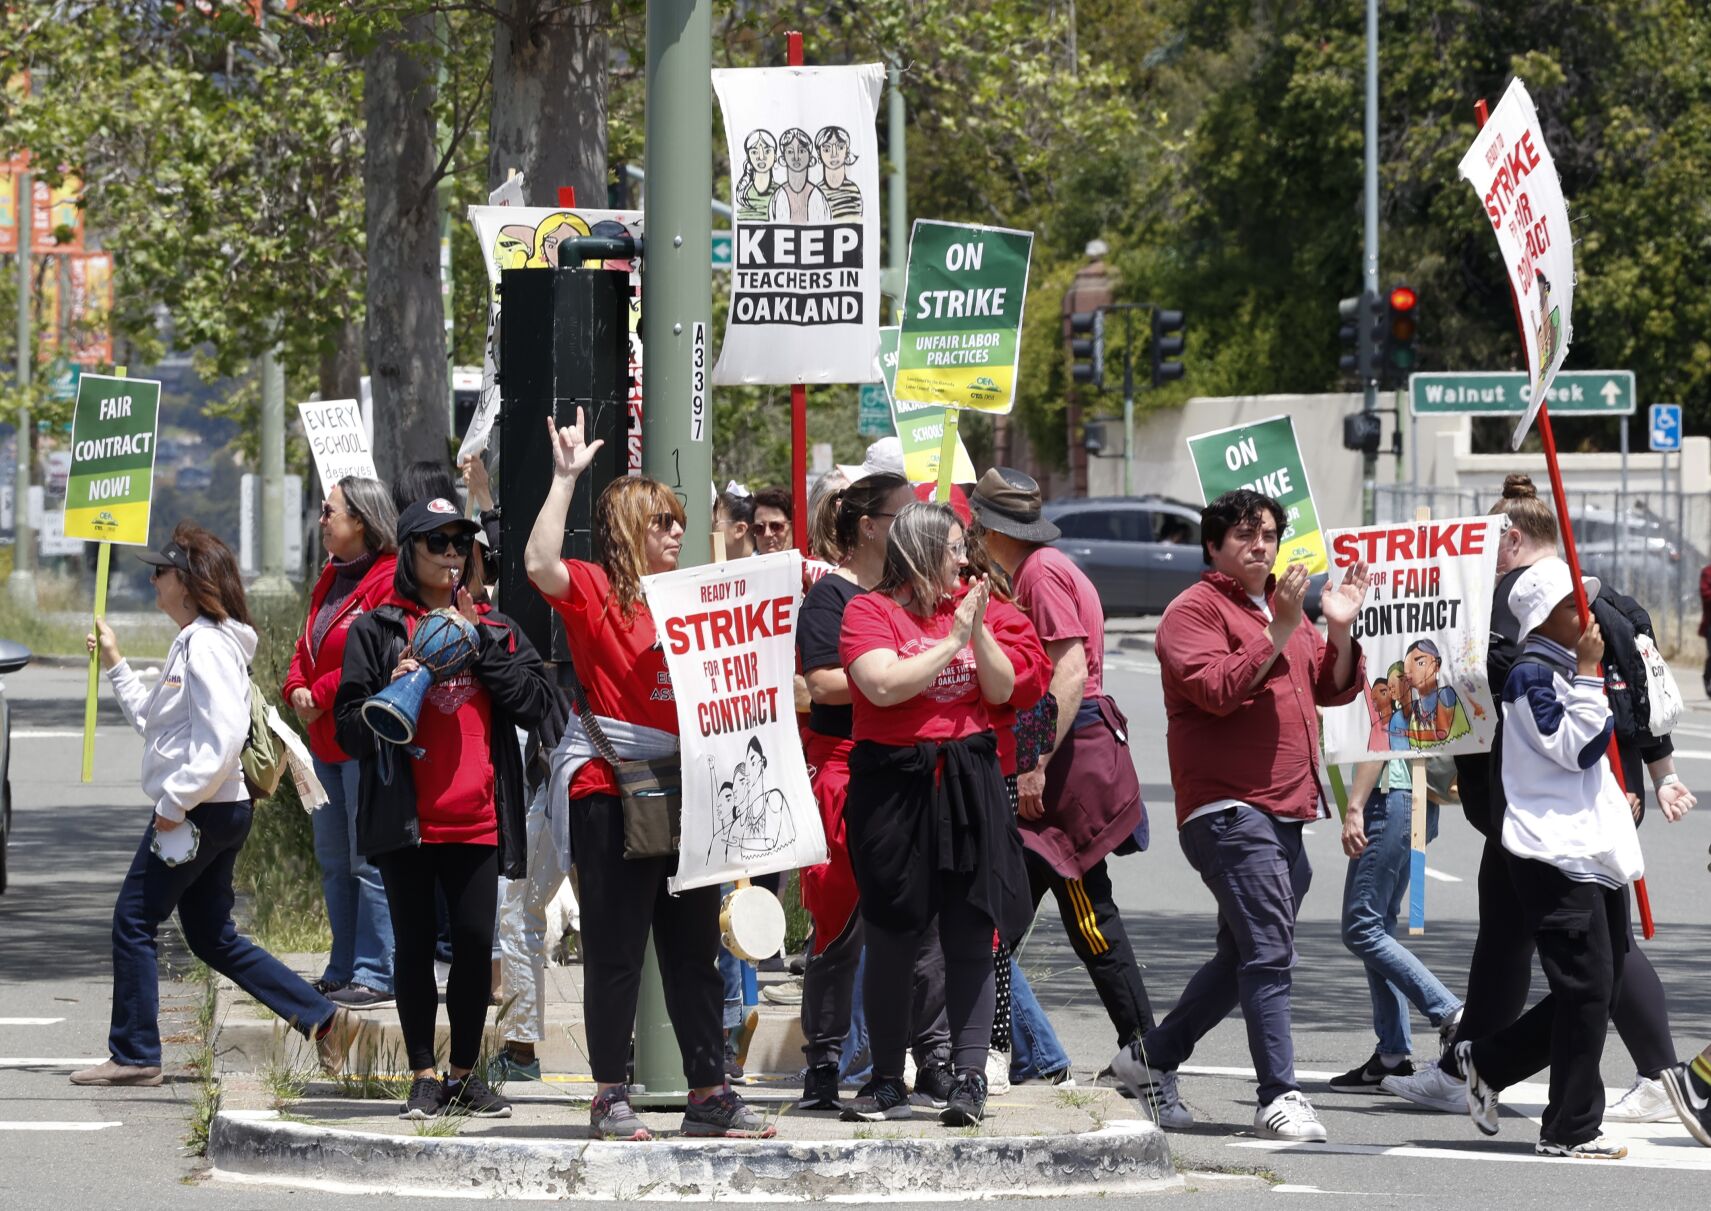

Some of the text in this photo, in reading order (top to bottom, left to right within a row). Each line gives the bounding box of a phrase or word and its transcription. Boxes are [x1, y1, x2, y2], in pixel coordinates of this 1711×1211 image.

[1485, 128, 1541, 230] STRIKE
[739, 227, 859, 265] KEEP
[945, 242, 984, 272] ON
[737, 270, 859, 290] TEACHERS IN
[736, 295, 859, 323] OAKLAND
[916, 287, 1007, 320] STRIKE
[916, 333, 1000, 351] UNFAIR LABOR
[926, 349, 989, 366] PRACTICES
[693, 324, 704, 440] A3397
[1425, 384, 1584, 404] Walnut Ceek
[99, 395, 132, 421] FAIR
[305, 406, 357, 430] EVERY
[313, 433, 368, 455] SCHOOL
[911, 423, 944, 442] SCHOOLS
[75, 432, 153, 462] CONTRACT
[1225, 437, 1258, 472] ON
[325, 463, 372, 479] deserves
[88, 475, 131, 501] NOW!
[1333, 522, 1487, 568] STRIKE
[700, 579, 746, 603] READY TO
[1369, 566, 1441, 599] FOR FAIR
[1374, 587, 1381, 601] A
[664, 595, 794, 655] STRIKE
[1352, 599, 1462, 640] CONTRACT
[703, 651, 759, 693] FOR FAIR
[938, 673, 970, 686] OAKLAND
[942, 667, 955, 676] ARE
[711, 677, 718, 694] A
[697, 686, 778, 738] CONTRACT
